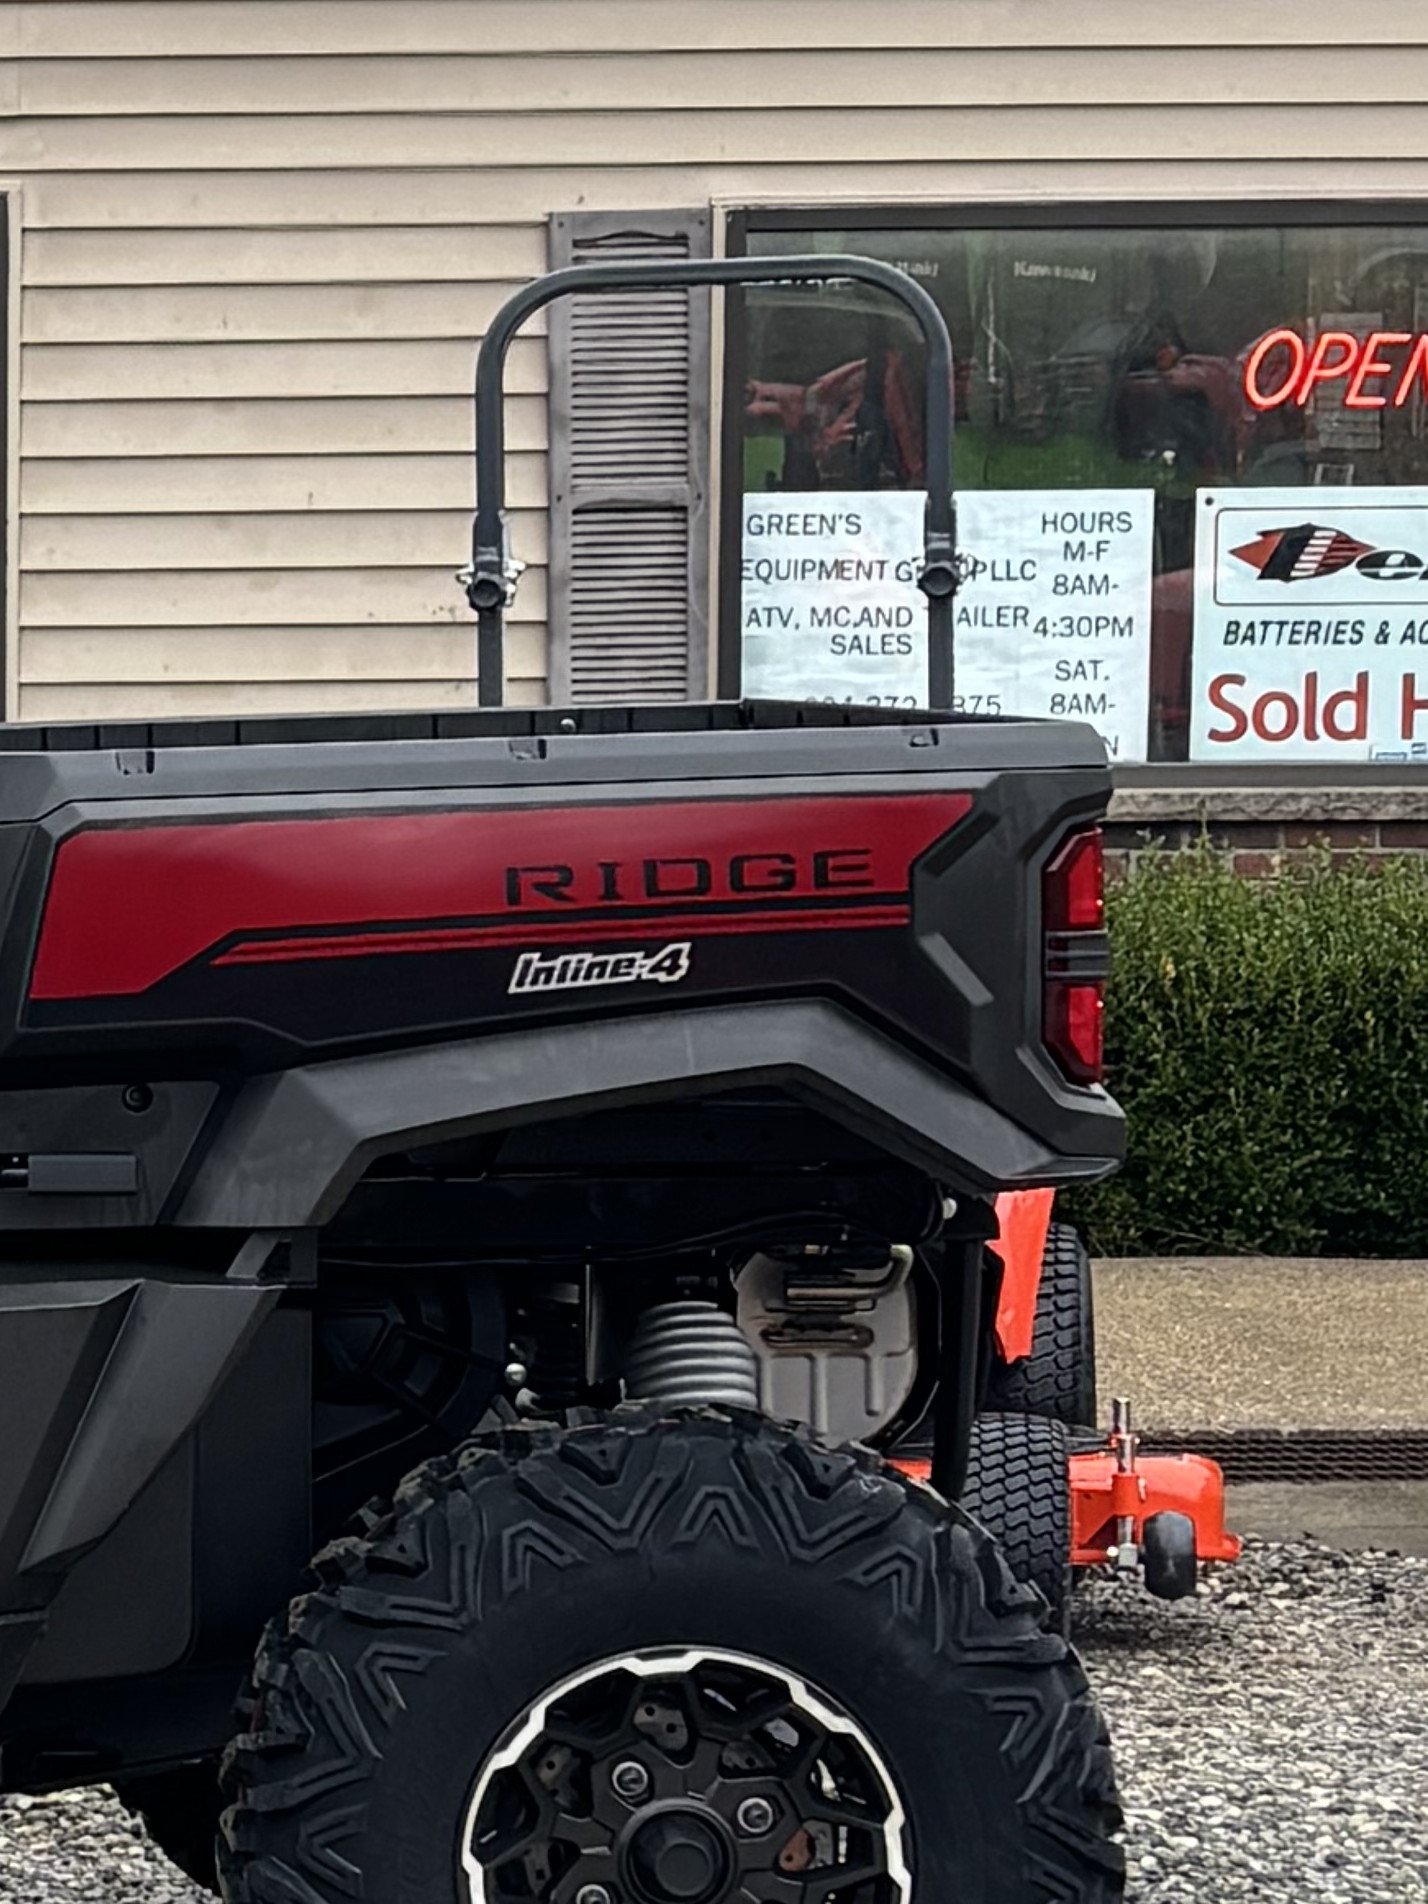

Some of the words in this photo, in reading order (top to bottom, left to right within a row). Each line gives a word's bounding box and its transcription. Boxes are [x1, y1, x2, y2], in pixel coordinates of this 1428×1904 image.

[746, 513, 862, 537] GREEN'S
[1041, 511, 1133, 534] HOURS
[1063, 540, 1111, 562] M-F
[741, 558, 888, 585] EQUIPMENT
[991, 559, 1037, 582] LLC
[1052, 573, 1120, 596] 8AM-
[746, 606, 800, 631] ATV,
[1033, 615, 1134, 639] 4:30PM
[830, 633, 913, 656] SALES
[1222, 619, 1366, 646] BATTERIES
[1373, 620, 1392, 645] &
[1055, 659, 1110, 682] SAT.
[1050, 693, 1116, 716] 8AM-
[1207, 669, 1369, 743] Sold
[505, 848, 875, 907] RIDGE
[509, 942, 693, 994] Inline-4
